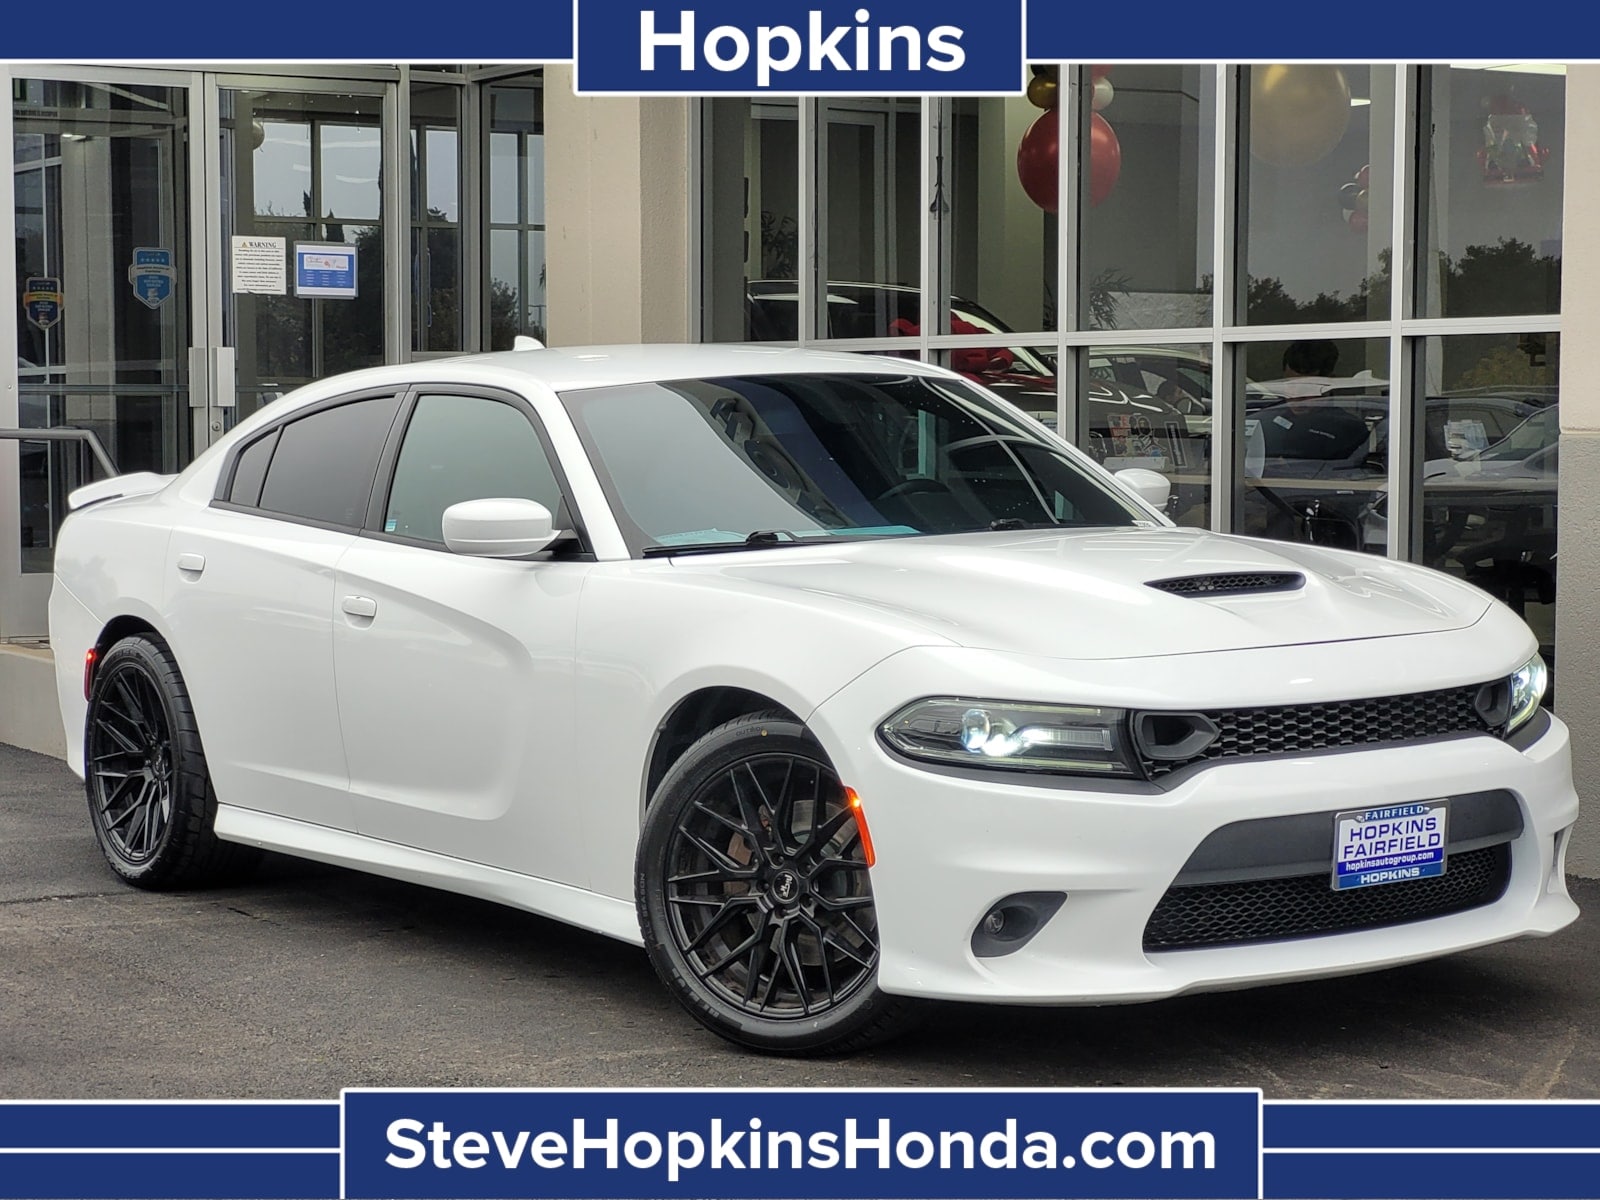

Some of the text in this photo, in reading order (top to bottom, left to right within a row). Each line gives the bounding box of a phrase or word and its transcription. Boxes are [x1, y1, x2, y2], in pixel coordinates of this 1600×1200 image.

[1365, 805, 1424, 820] FAIRFIELD
[1350, 817, 1436, 842] HOPKINS
[1343, 833, 1441, 859] FAIRFIELD
[1345, 851, 1435, 872] hopkinsautogroup.com
[1360, 867, 1420, 884] HOPKINS
